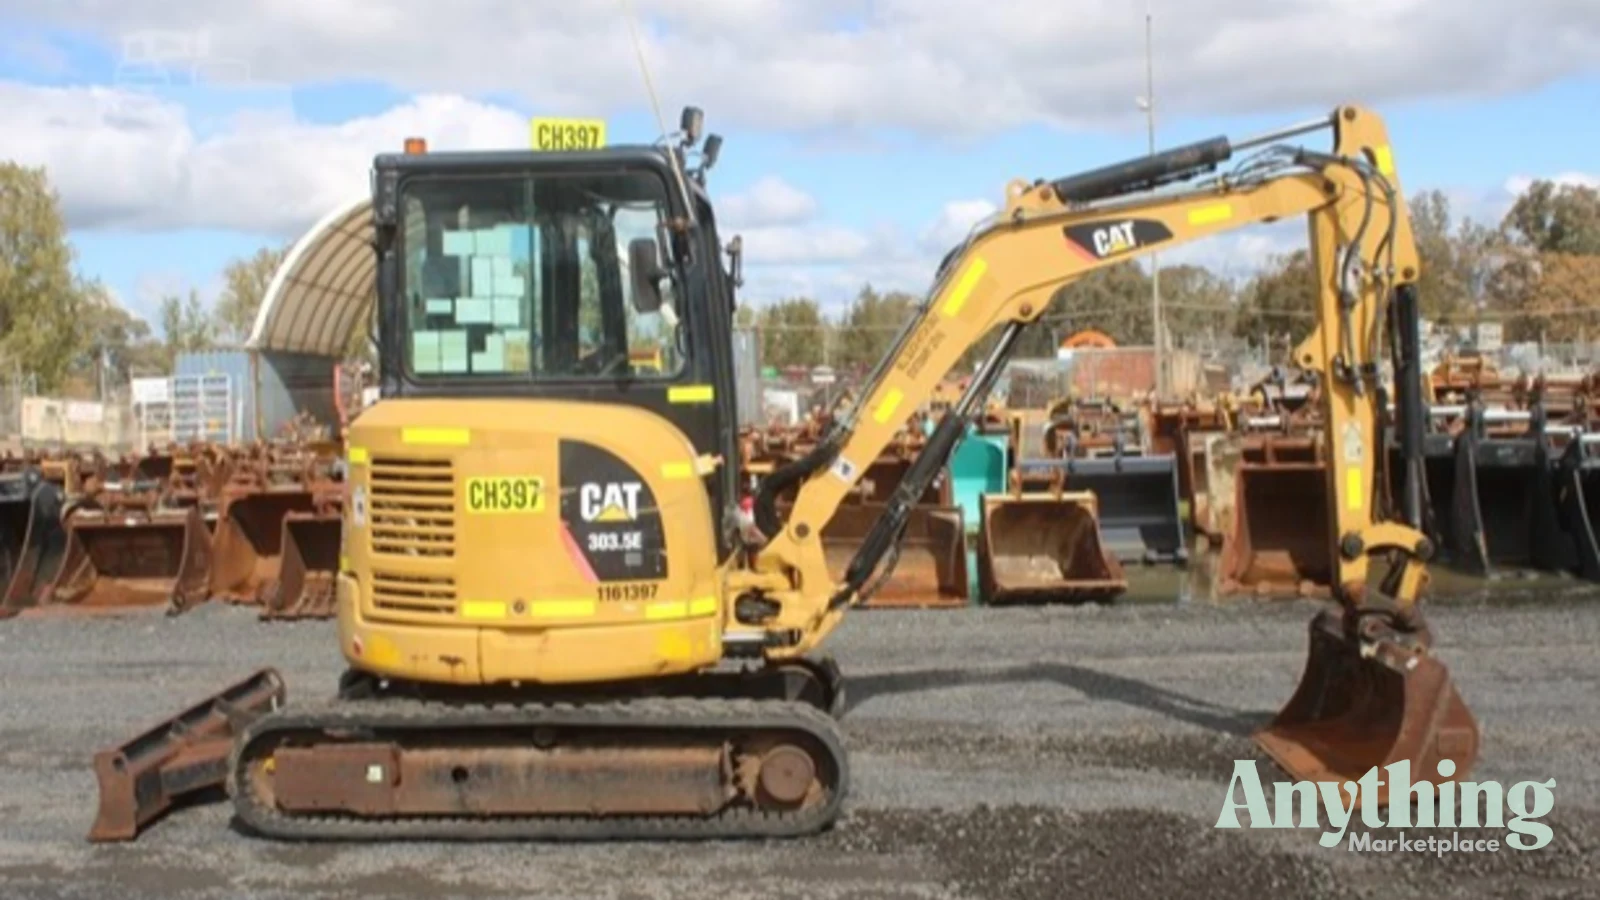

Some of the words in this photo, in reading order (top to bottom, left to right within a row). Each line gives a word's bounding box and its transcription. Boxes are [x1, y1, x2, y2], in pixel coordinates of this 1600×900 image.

[538, 123, 599, 149] CH397
[1093, 221, 1136, 256] CAT
[470, 480, 539, 509] CH397
[580, 483, 641, 521] CAT
[588, 532, 642, 550] 303.5E
[597, 584, 658, 601] 1161397
